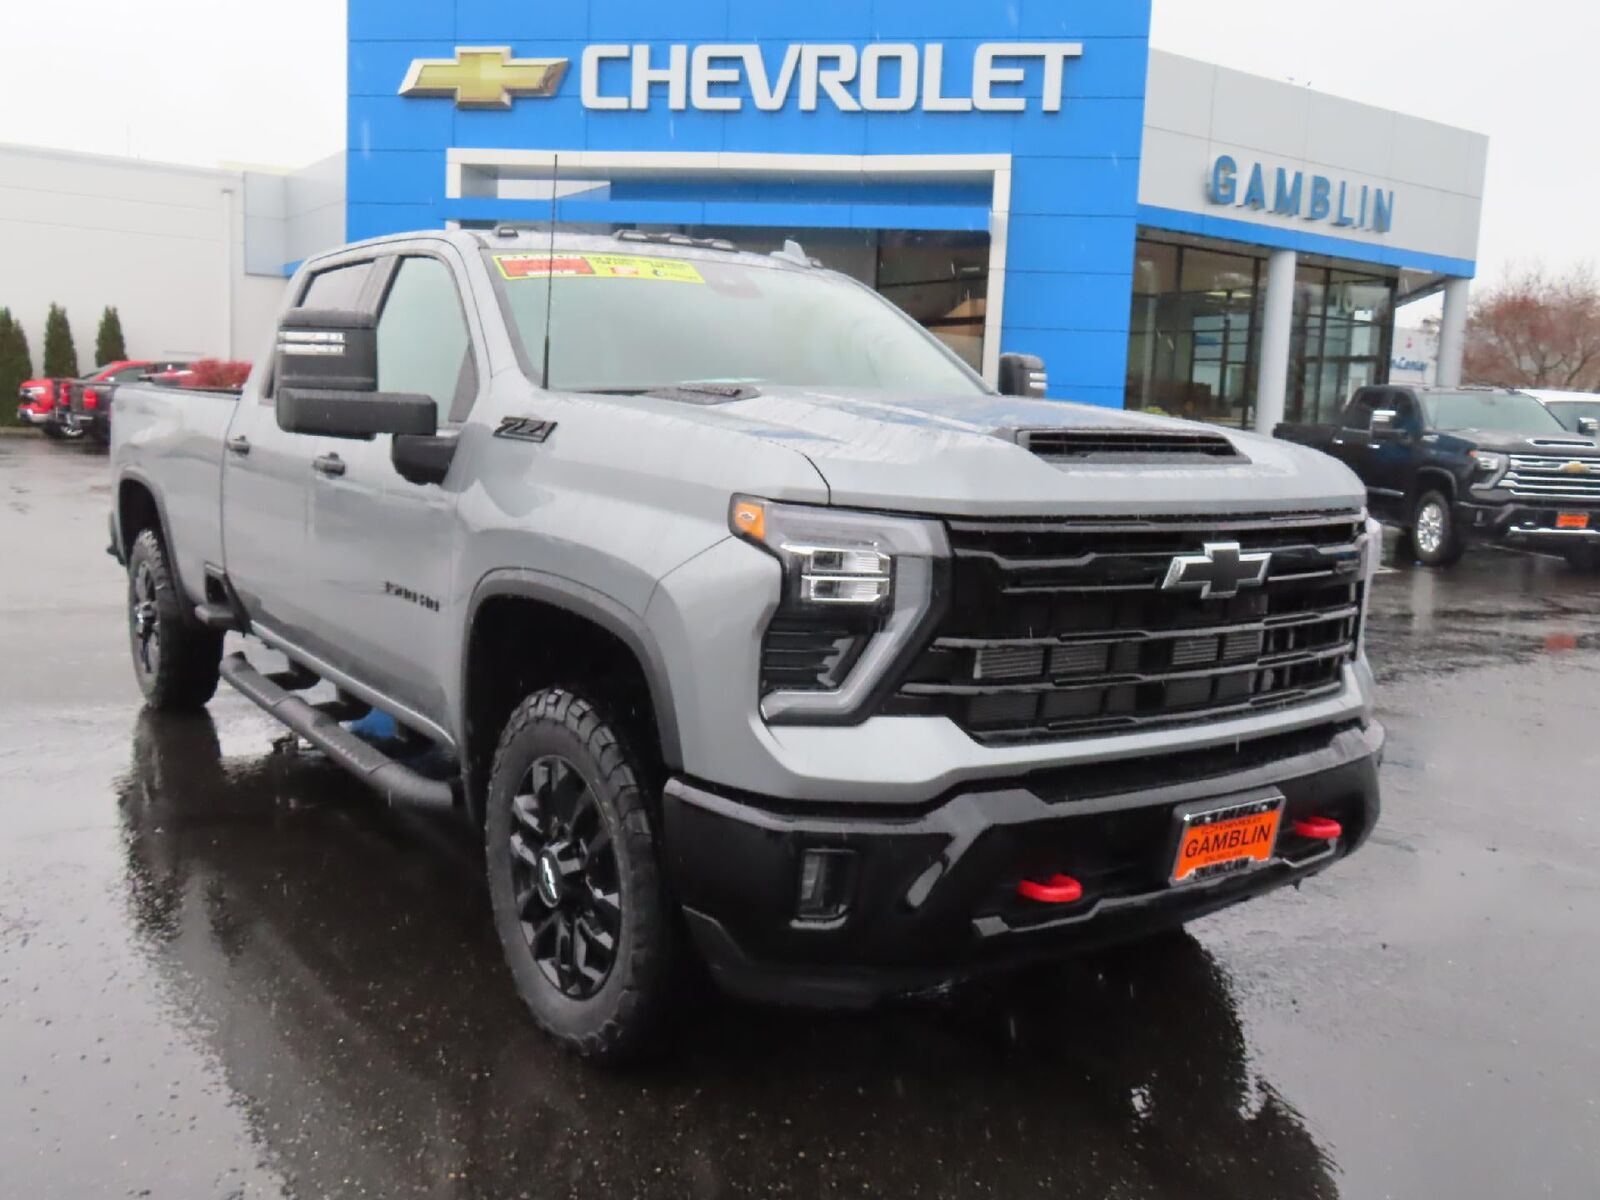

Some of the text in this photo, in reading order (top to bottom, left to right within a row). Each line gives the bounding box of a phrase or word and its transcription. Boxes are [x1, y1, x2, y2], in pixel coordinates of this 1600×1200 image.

[581, 42, 1083, 112] CHEVROLET
[1208, 154, 1394, 233] GAMBLIN
[1185, 824, 1272, 858] GAMBLIN
